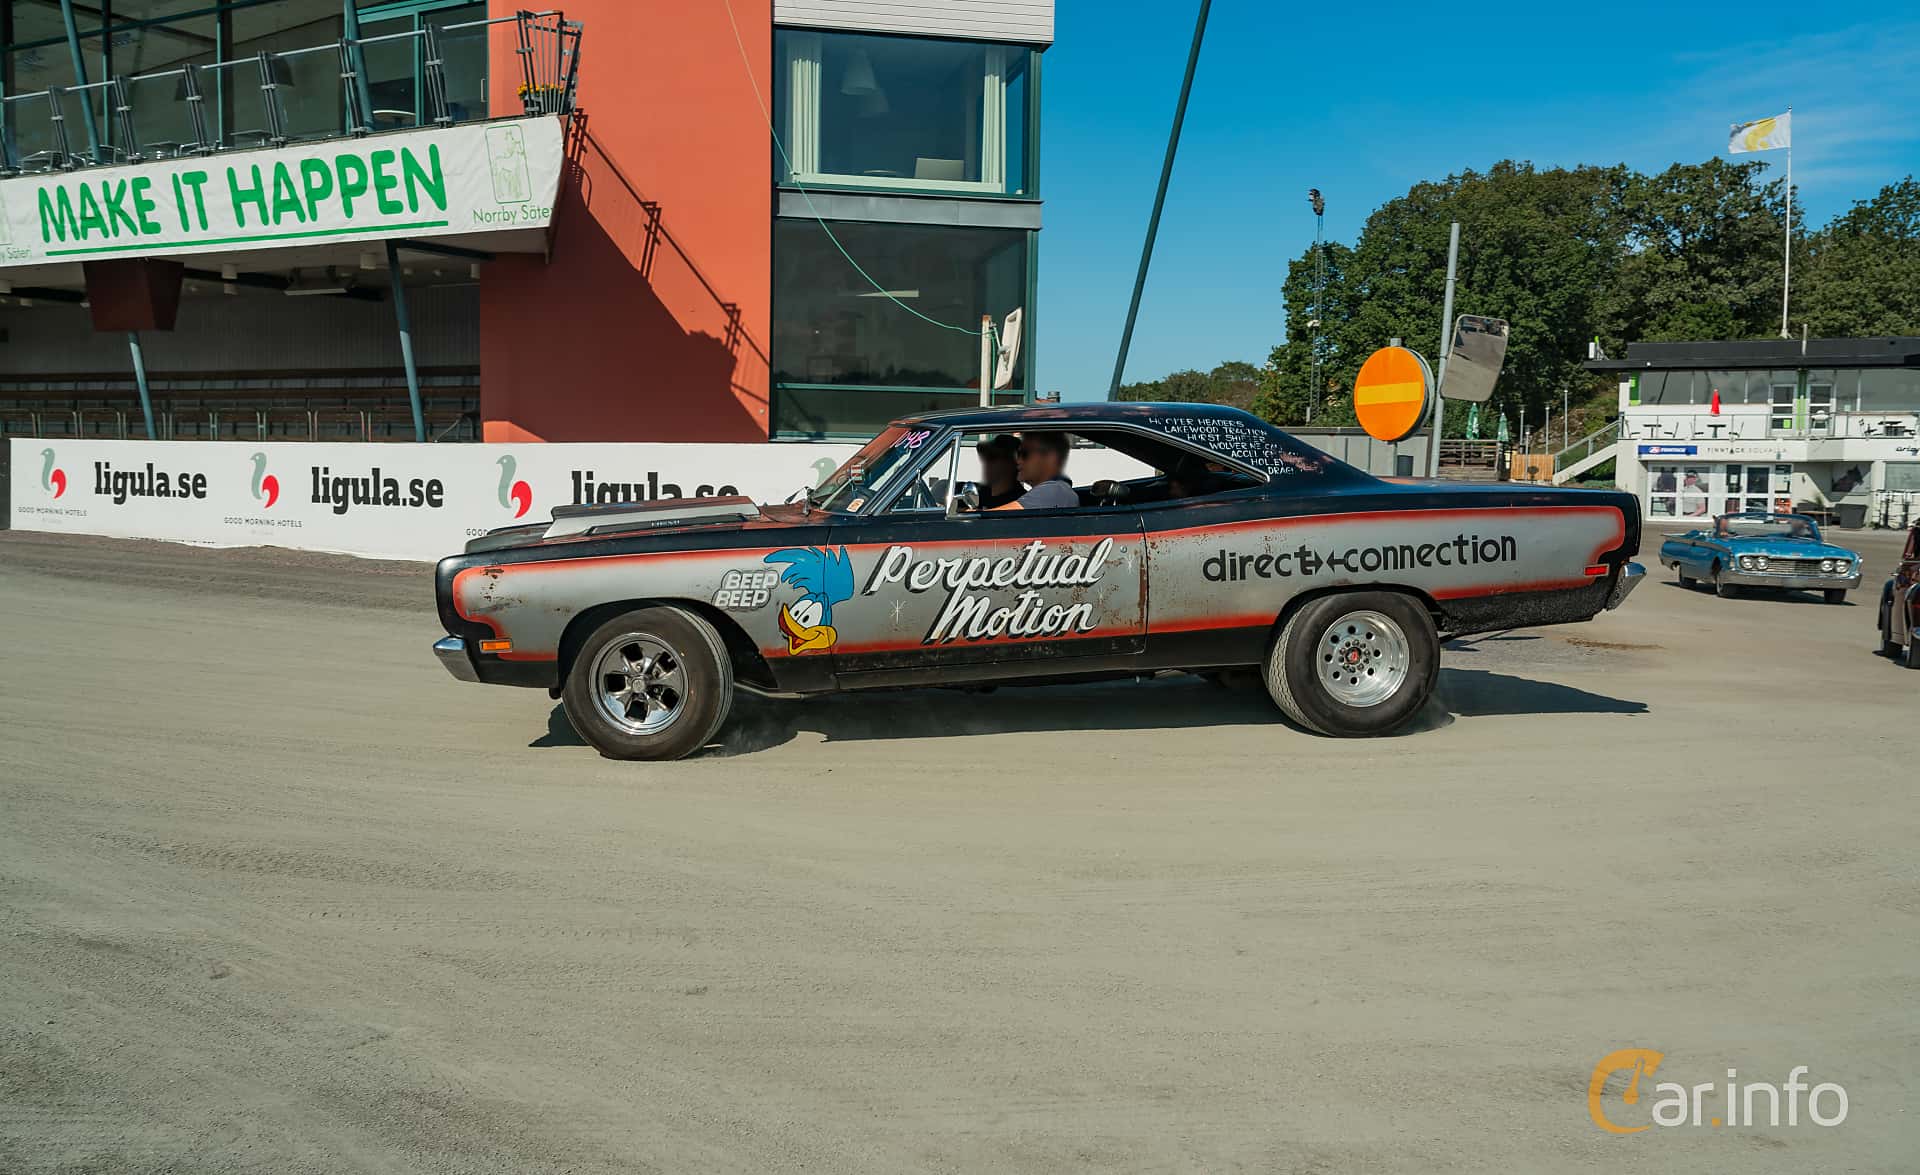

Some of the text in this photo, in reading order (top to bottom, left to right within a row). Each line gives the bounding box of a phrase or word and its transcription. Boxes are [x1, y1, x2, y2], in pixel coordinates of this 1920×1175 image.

[37, 144, 447, 244] MAKE IT HAPPEN
[473, 205, 555, 224] Norrby Säte
[1164, 425, 1219, 434] LAKEWOOD
[1209, 441, 1261, 450] WOLVERNE
[95, 462, 207, 505] ligula.se
[312, 467, 444, 515] ligula.se
[278, 520, 302, 528] HOTELS
[863, 538, 1113, 600] Perpetual
[1203, 534, 1516, 581] direct connection
[724, 572, 779, 589] BEEP
[713, 589, 770, 608] BEEP
[922, 590, 1099, 645] Motion
